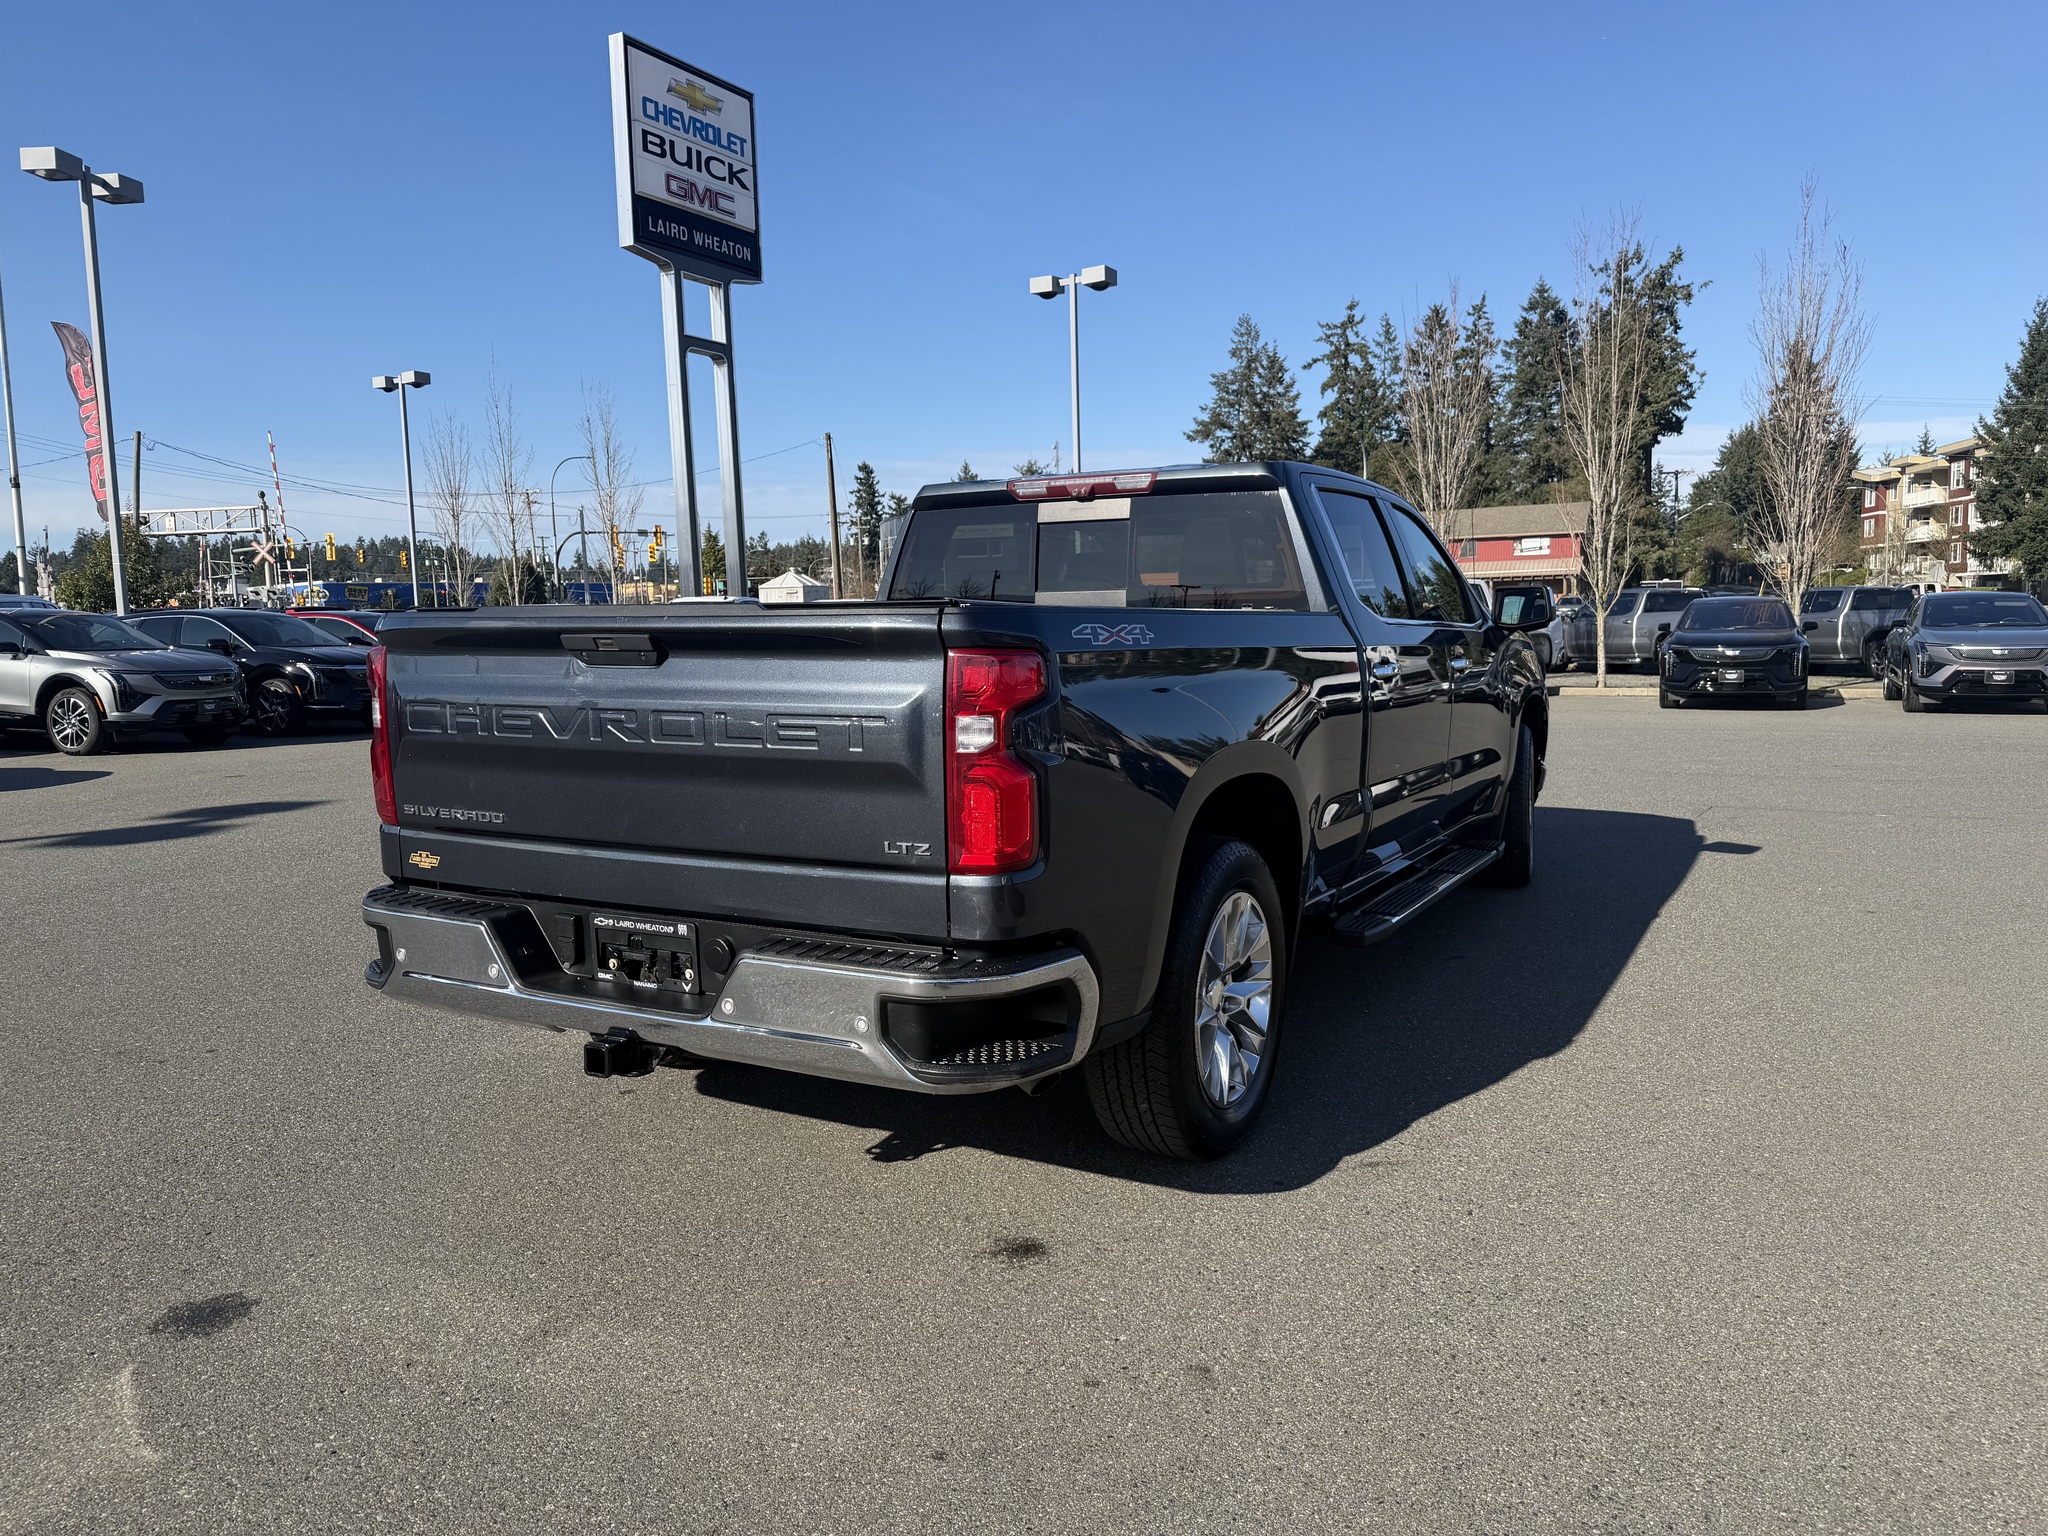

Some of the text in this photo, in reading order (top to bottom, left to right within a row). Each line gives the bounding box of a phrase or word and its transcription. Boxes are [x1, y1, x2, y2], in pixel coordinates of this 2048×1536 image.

[641, 95, 748, 158] CHEVROLET
[641, 128, 751, 192] BUICK
[664, 170, 737, 220] GMC
[648, 215, 752, 262] LAIRD WHEATON
[1071, 623, 1155, 645] 4X4
[405, 701, 888, 752] CHEVROLET
[403, 804, 505, 824] SILVERADO
[883, 840, 932, 856] LTZ
[614, 919, 671, 934] LAIRD WHEATON
[597, 972, 614, 980] GMC
